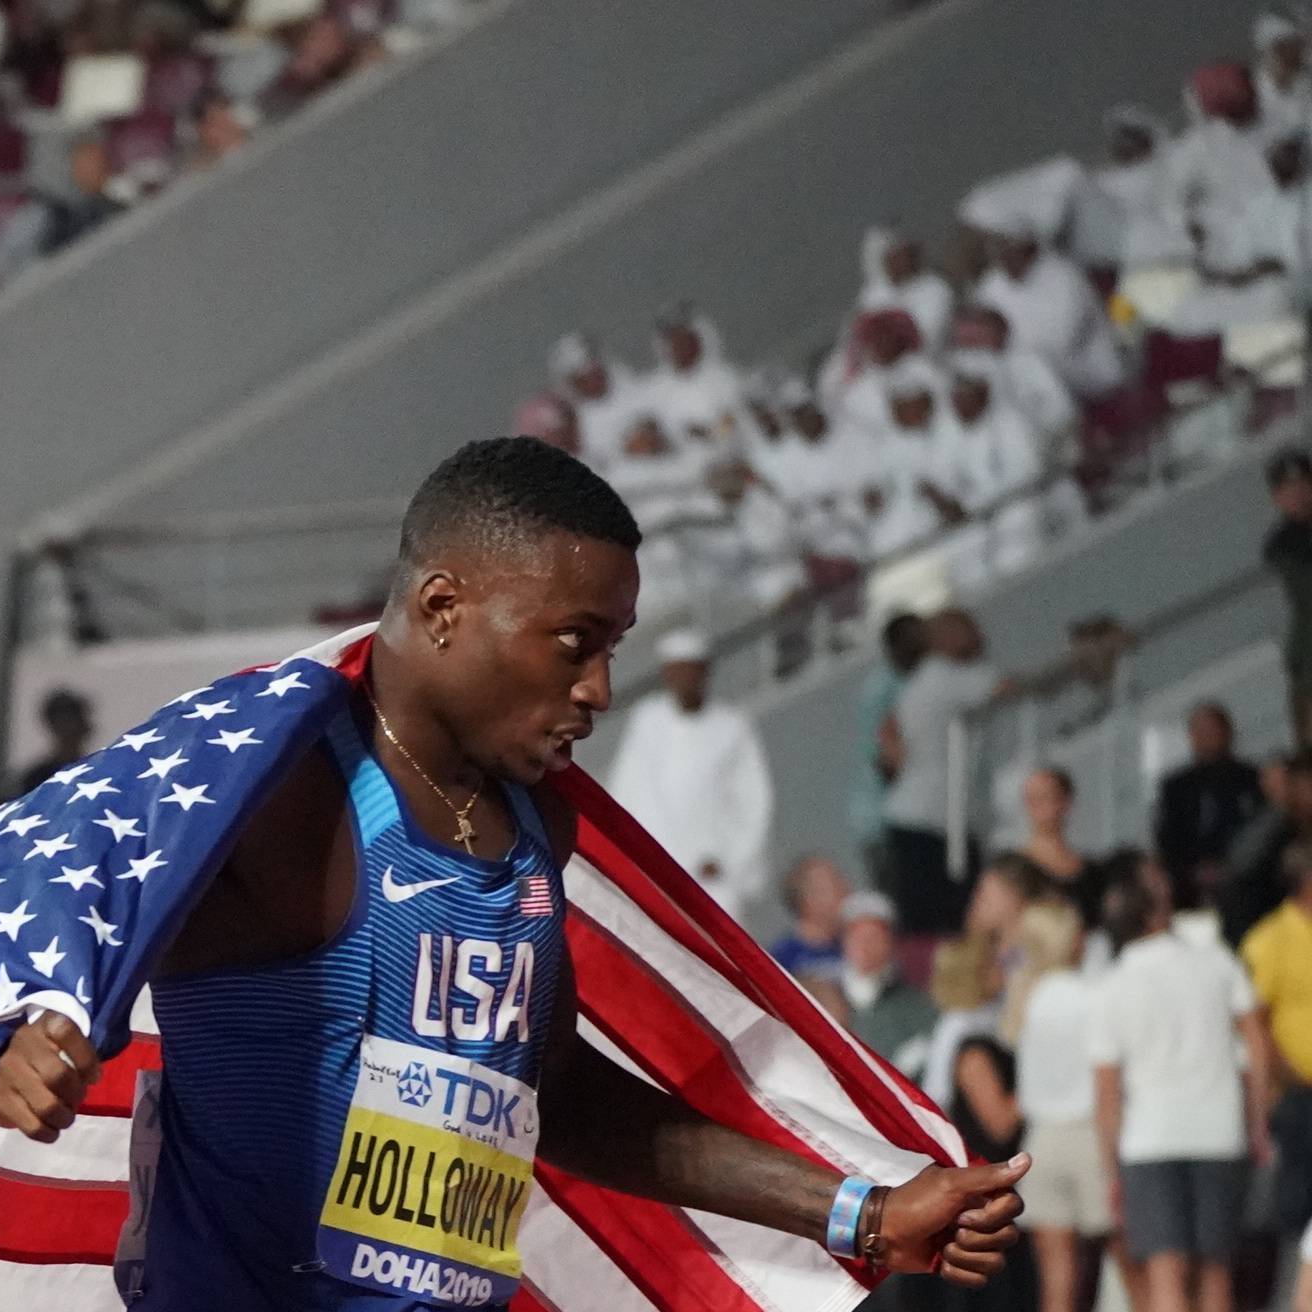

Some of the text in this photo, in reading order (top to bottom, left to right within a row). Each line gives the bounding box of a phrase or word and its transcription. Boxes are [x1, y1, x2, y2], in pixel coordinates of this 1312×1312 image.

[411, 932, 535, 1043] USA
[436, 1068, 521, 1139] TDK
[336, 1131, 526, 1251] HOLLOWAY
[351, 1243, 493, 1307] DOHA2019
